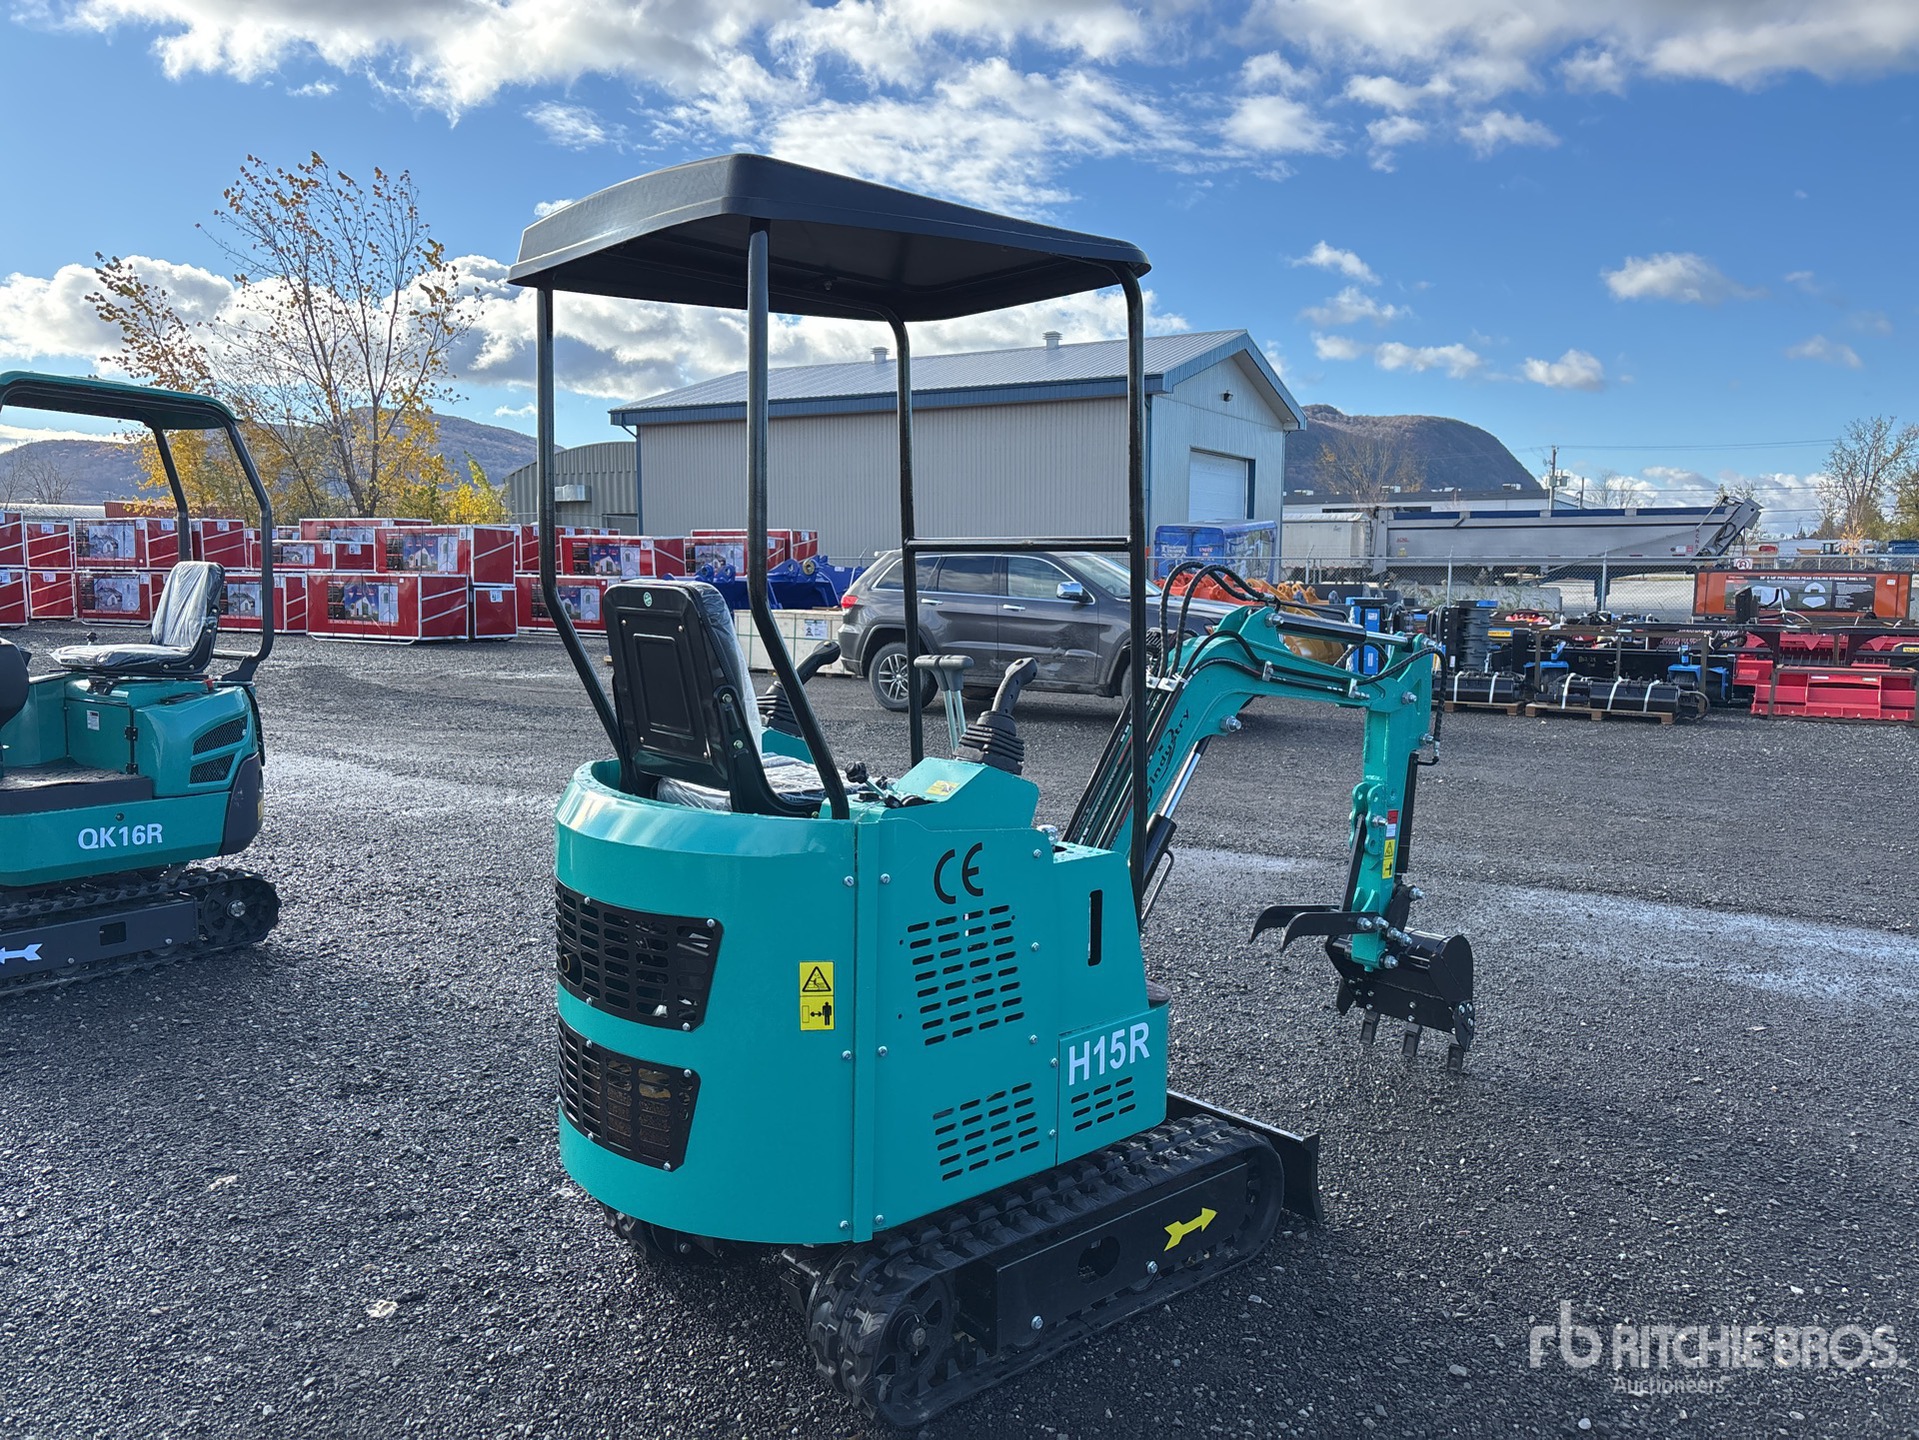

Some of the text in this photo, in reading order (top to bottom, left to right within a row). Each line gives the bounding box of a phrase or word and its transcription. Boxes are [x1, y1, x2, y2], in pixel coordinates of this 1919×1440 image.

[78, 823, 163, 850] QK16R
[933, 841, 984, 905] CE
[1068, 1022, 1150, 1086] H15R
